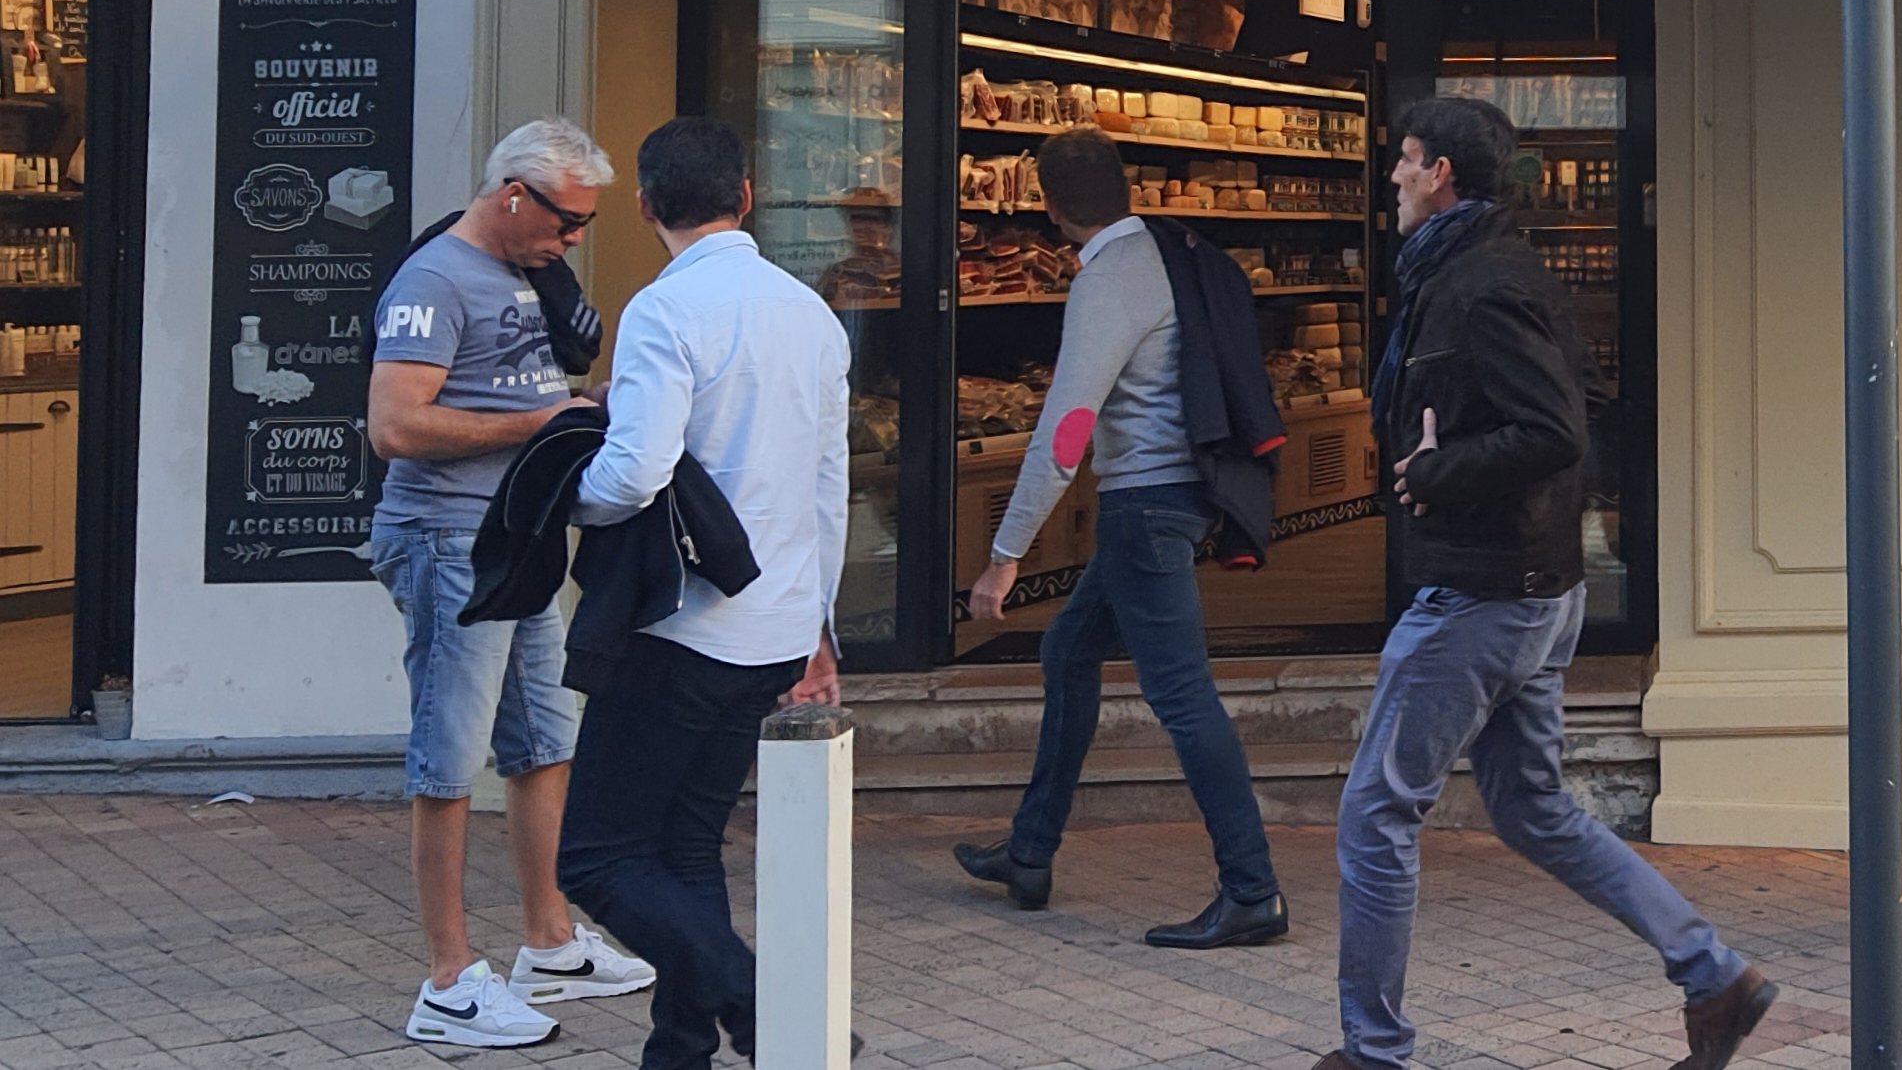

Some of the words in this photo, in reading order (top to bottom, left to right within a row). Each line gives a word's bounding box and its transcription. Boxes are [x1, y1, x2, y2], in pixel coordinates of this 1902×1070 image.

[254, 58, 378, 79] SOUVENIR
[272, 90, 361, 127] officiel
[265, 132, 285, 144] DU
[288, 131, 365, 144] SUD-OUEST
[250, 186, 308, 208] SAVONS
[249, 262, 372, 282] SHAMPOINGS
[328, 315, 363, 338] LA
[379, 304, 435, 339] JPN
[266, 427, 346, 450] SOINS
[262, 453, 295, 469] du
[297, 453, 351, 473] corps
[266, 473, 283, 493] ET
[286, 473, 302, 492] DU
[305, 472, 347, 492] VISAGE
[226, 516, 371, 535] ACCESSOIRE
